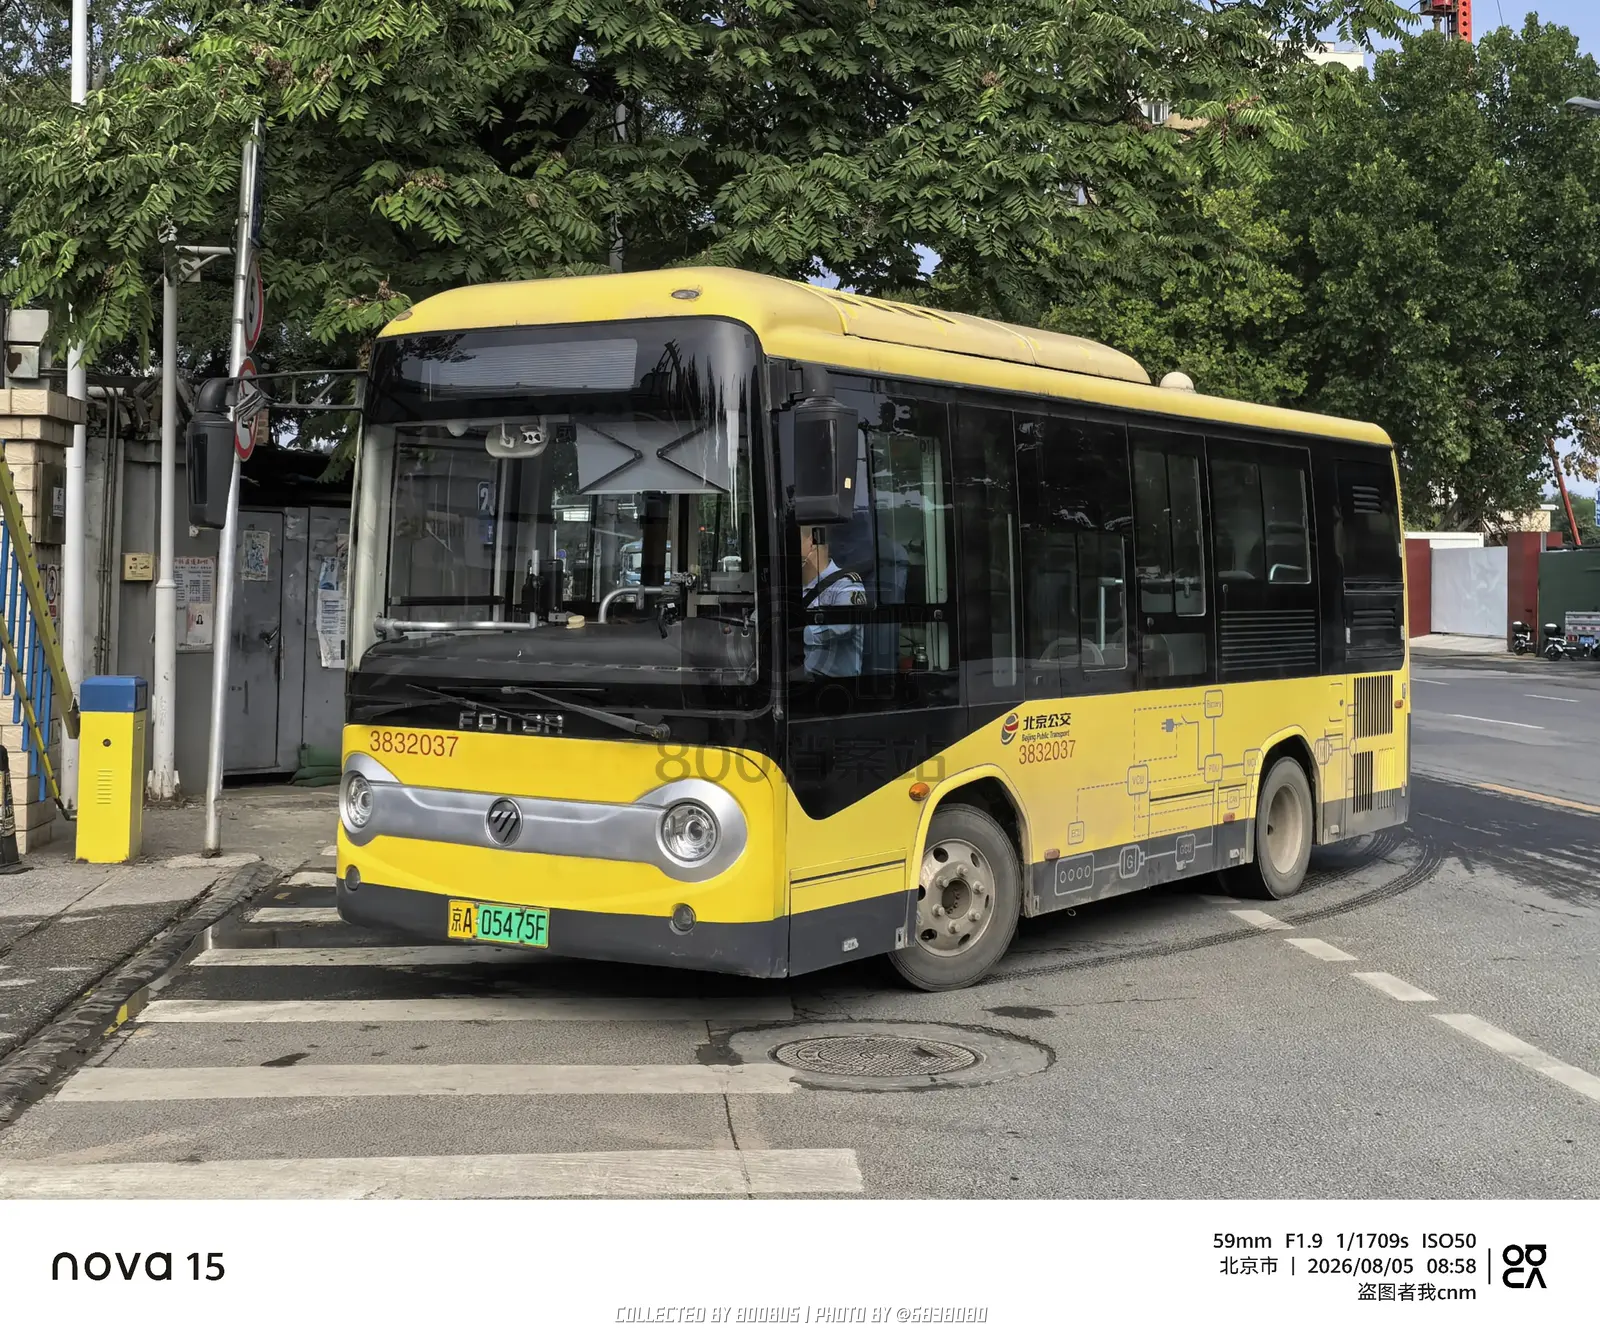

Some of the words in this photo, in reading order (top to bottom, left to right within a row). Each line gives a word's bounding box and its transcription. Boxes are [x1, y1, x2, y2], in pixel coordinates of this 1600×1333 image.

[1023, 712, 1072, 731] 北京公交
[370, 730, 459, 758] 3832037
[1022, 733, 1037, 743] Beijing
[1036, 732, 1050, 740] Public
[1049, 730, 1070, 739] Transport
[1018, 739, 1076, 765] 3832037
